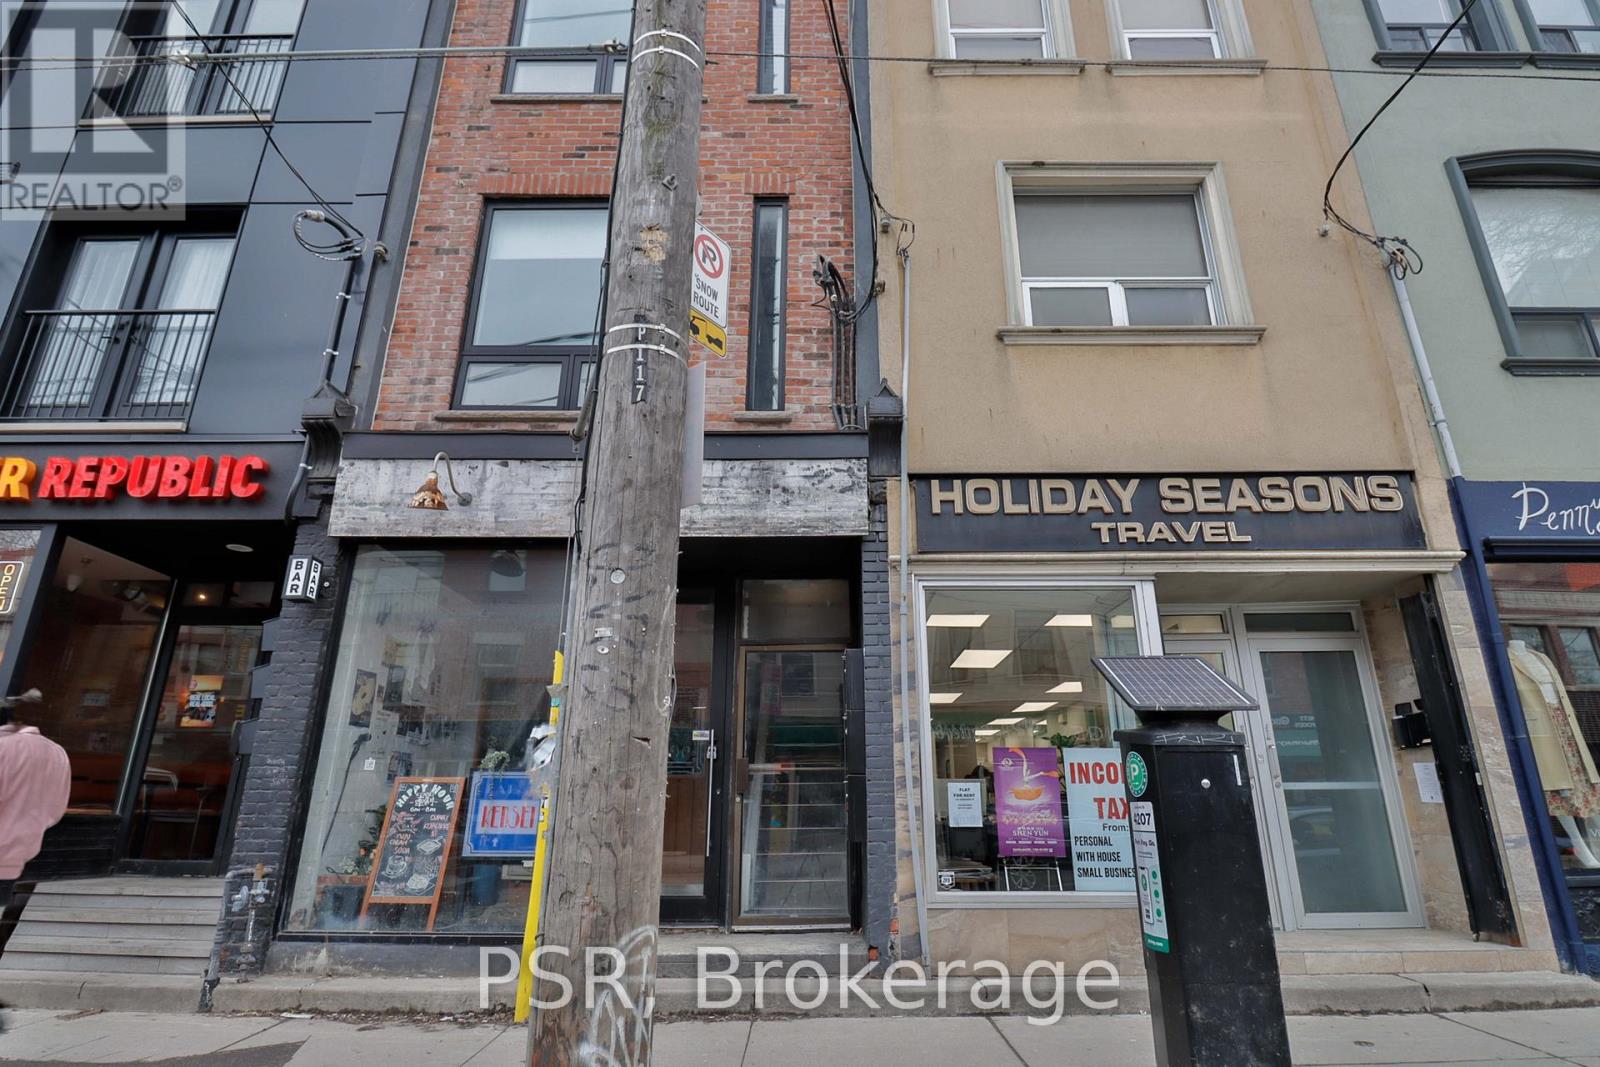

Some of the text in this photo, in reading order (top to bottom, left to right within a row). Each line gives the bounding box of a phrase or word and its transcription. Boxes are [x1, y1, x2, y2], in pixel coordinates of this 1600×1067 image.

[695, 278, 718, 302] SNOW
[693, 291, 720, 319] ROUTE
[37, 455, 270, 500] REPUBLIC
[929, 475, 1404, 515] HOLIDAY SEASONS
[1091, 521, 1252, 544] TRAVEL
[289, 560, 304, 594] BAR
[308, 562, 319, 597] BAR
[1069, 762, 1126, 784] INCO
[396, 783, 429, 808] HAPPY
[1102, 823, 1129, 831] From:
[1074, 836, 1113, 846] PERSONAL
[1075, 851, 1121, 862] WITH HOUSE
[1077, 867, 1103, 878] SMALL
